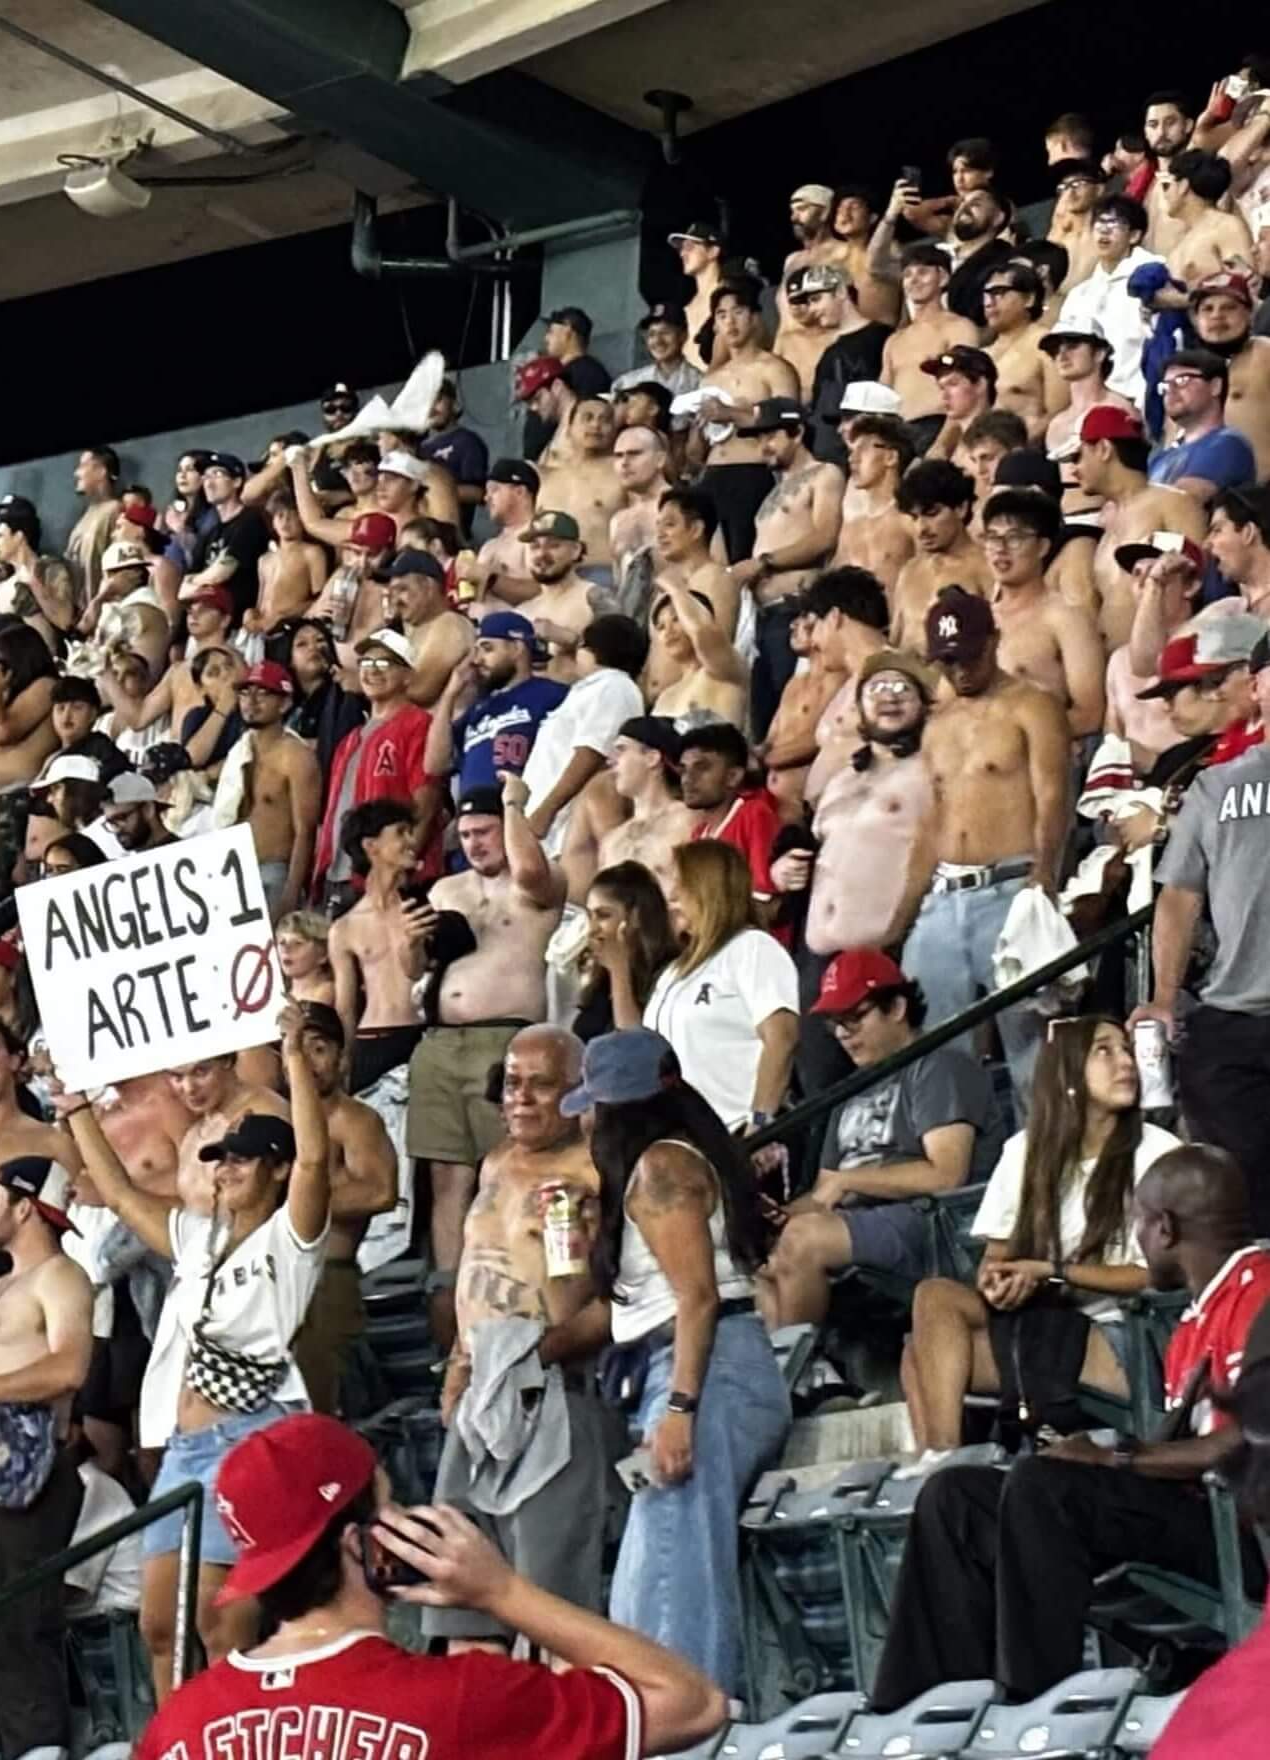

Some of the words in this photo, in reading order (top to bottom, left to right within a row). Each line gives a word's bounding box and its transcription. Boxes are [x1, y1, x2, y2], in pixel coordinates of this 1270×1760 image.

[372, 739, 398, 777] A
[493, 733, 529, 766] 50
[1218, 781, 1270, 822] AN
[221, 848, 264, 927] 1
[158, 1704, 430, 1760] ETCHE
